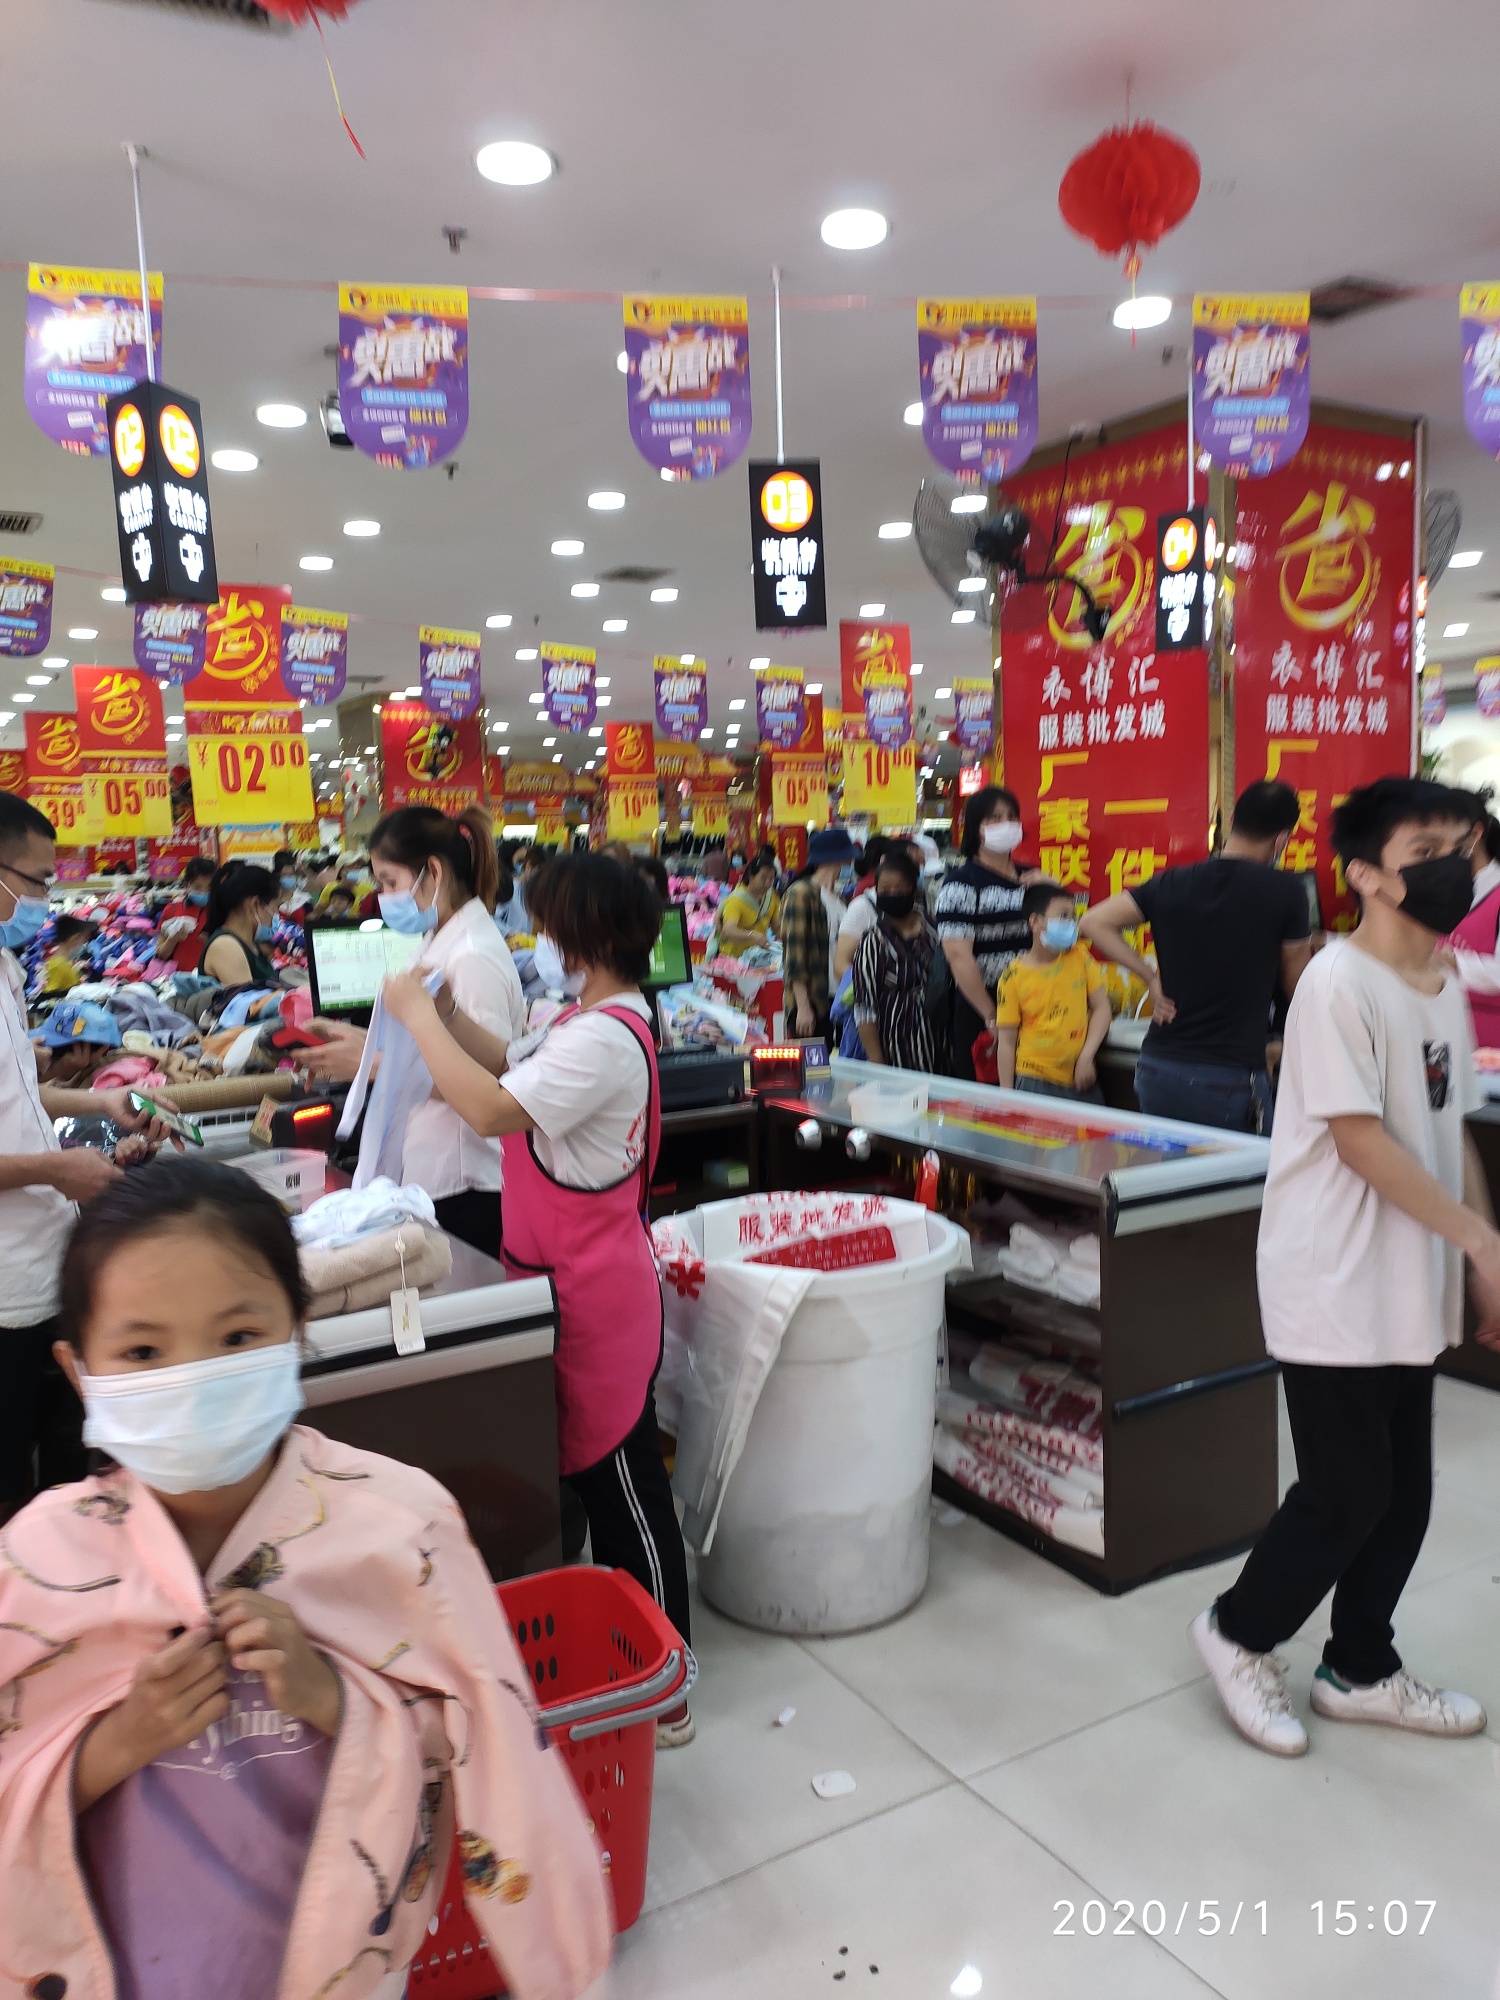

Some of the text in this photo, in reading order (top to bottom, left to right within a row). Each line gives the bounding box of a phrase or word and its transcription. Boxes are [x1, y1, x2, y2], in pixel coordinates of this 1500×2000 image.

[116, 410, 144, 471] 02
[161, 411, 198, 475] 02
[766, 479, 807, 523] 03
[1164, 524, 1195, 566] 04
[1038, 699, 1167, 751] 服装批发城
[1265, 693, 1389, 735] 服装批发城
